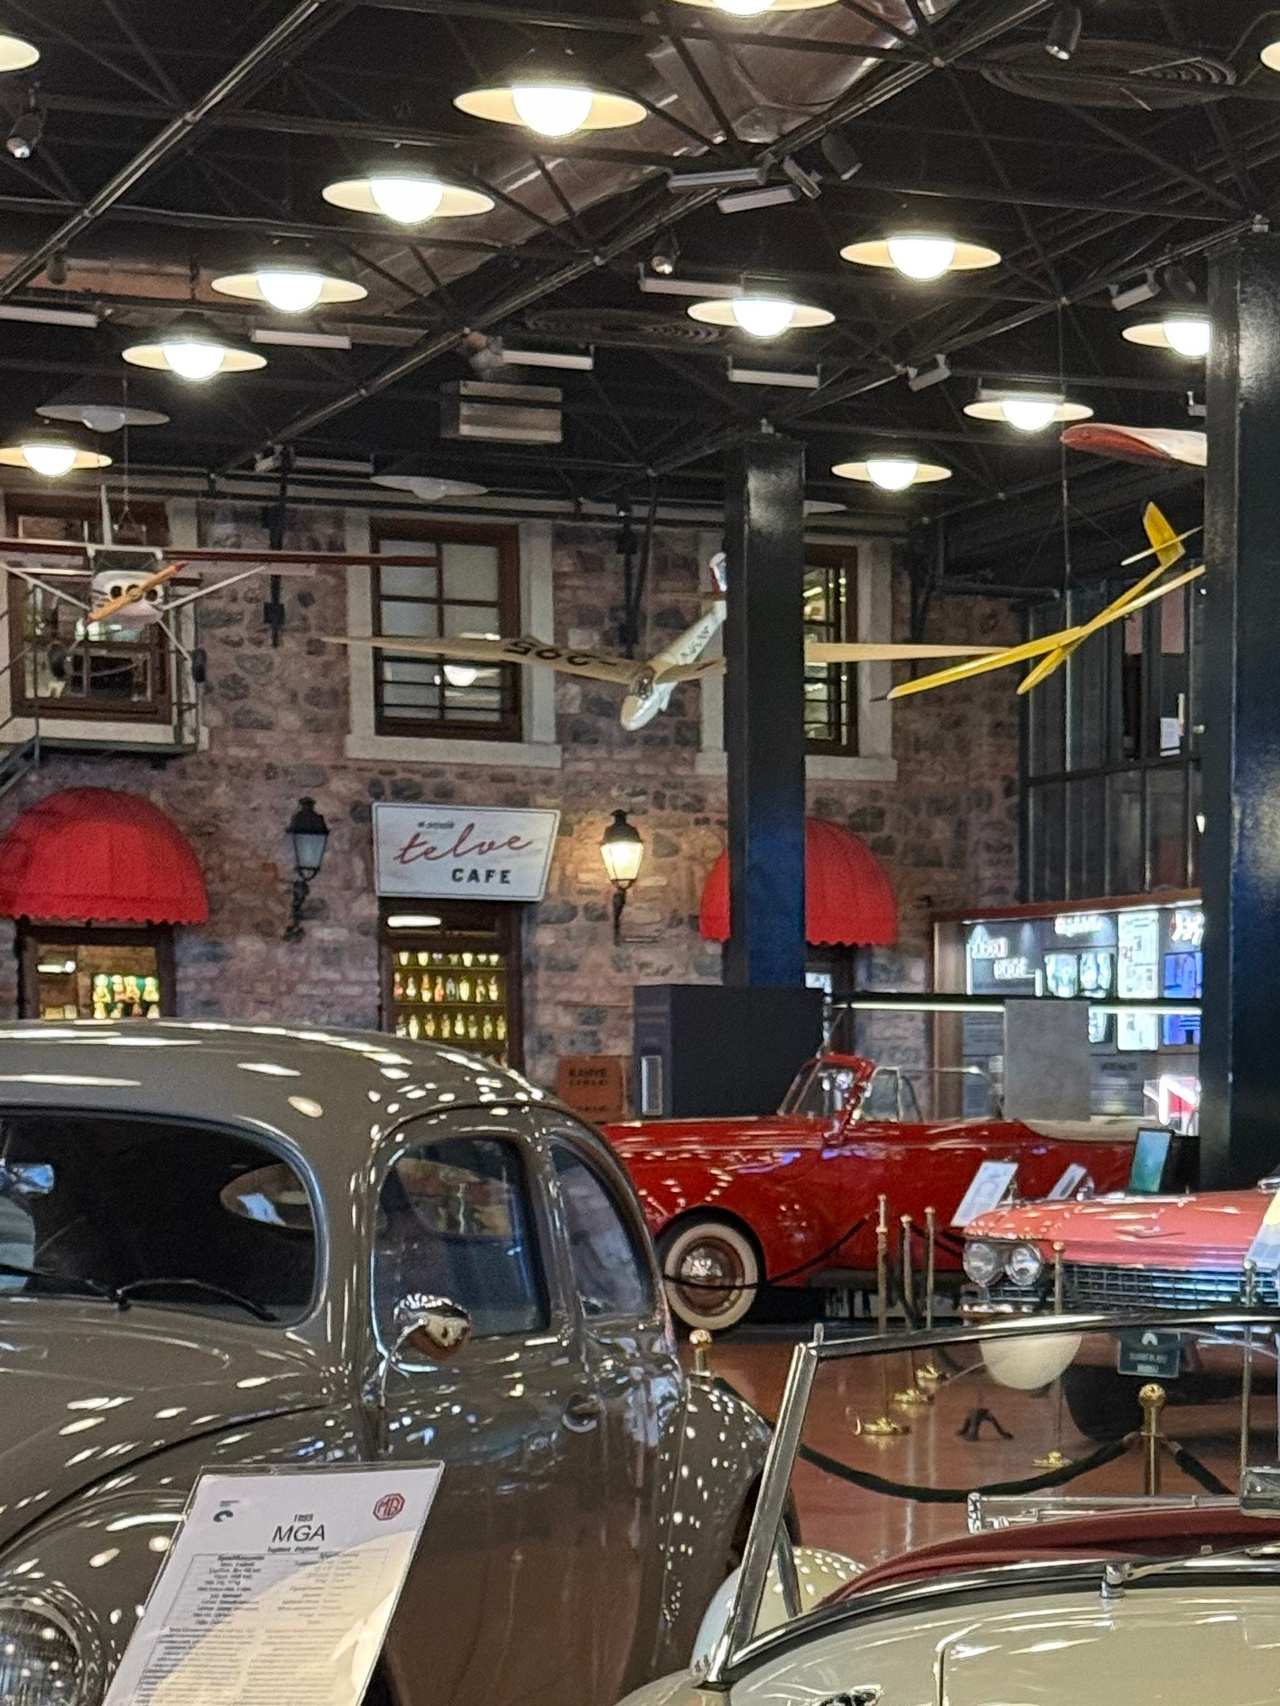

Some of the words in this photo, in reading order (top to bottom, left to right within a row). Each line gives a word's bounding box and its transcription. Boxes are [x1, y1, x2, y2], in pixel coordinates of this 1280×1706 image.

[393, 823, 534, 865] telve
[452, 868, 511, 884] CAFE
[271, 1524, 326, 1543] MGA
